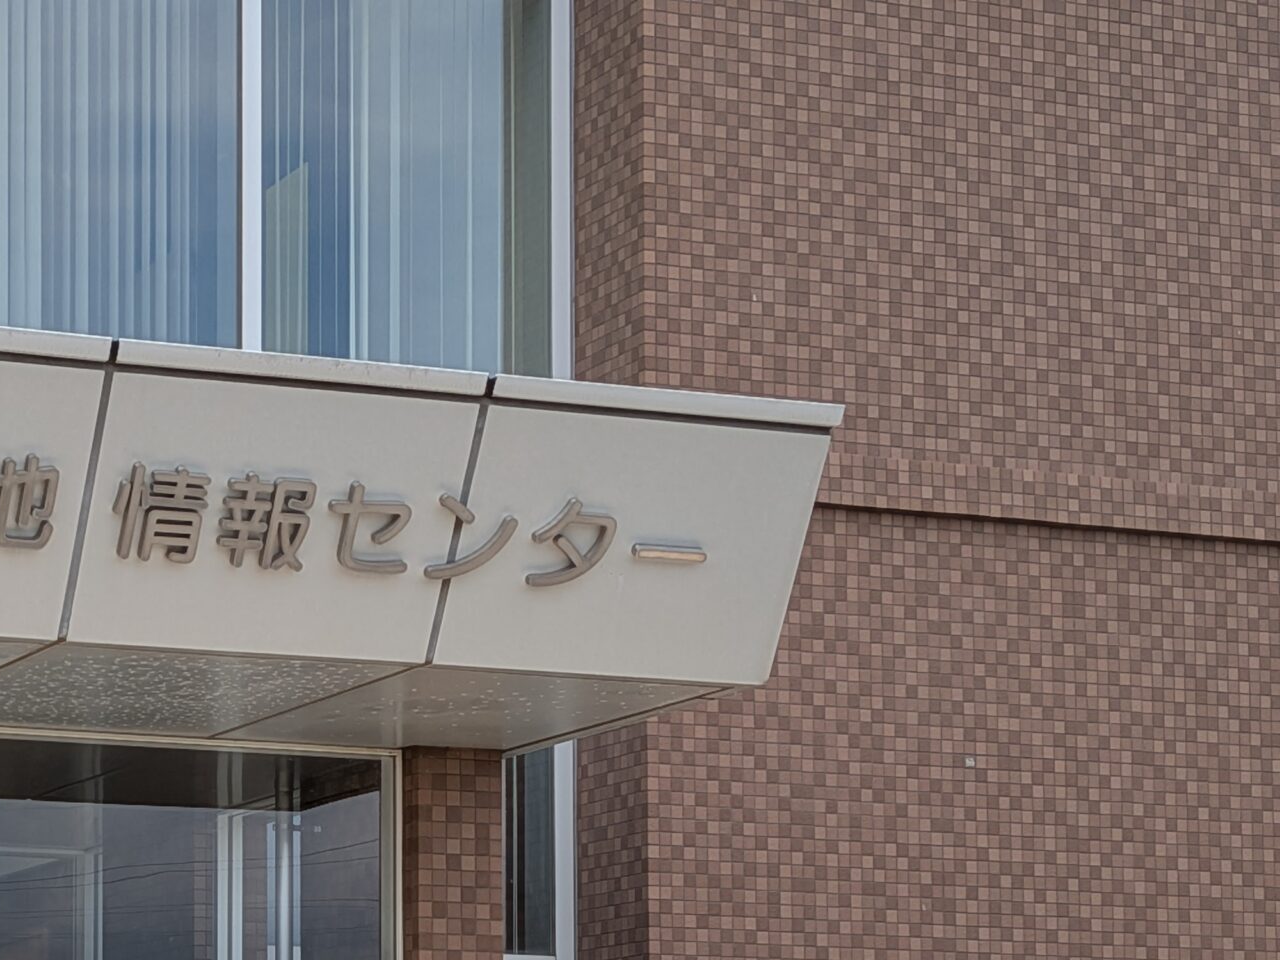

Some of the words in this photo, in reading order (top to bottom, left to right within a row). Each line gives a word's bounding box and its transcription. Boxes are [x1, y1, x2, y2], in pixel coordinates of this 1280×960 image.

[113, 459, 708, 588] 情報センター
